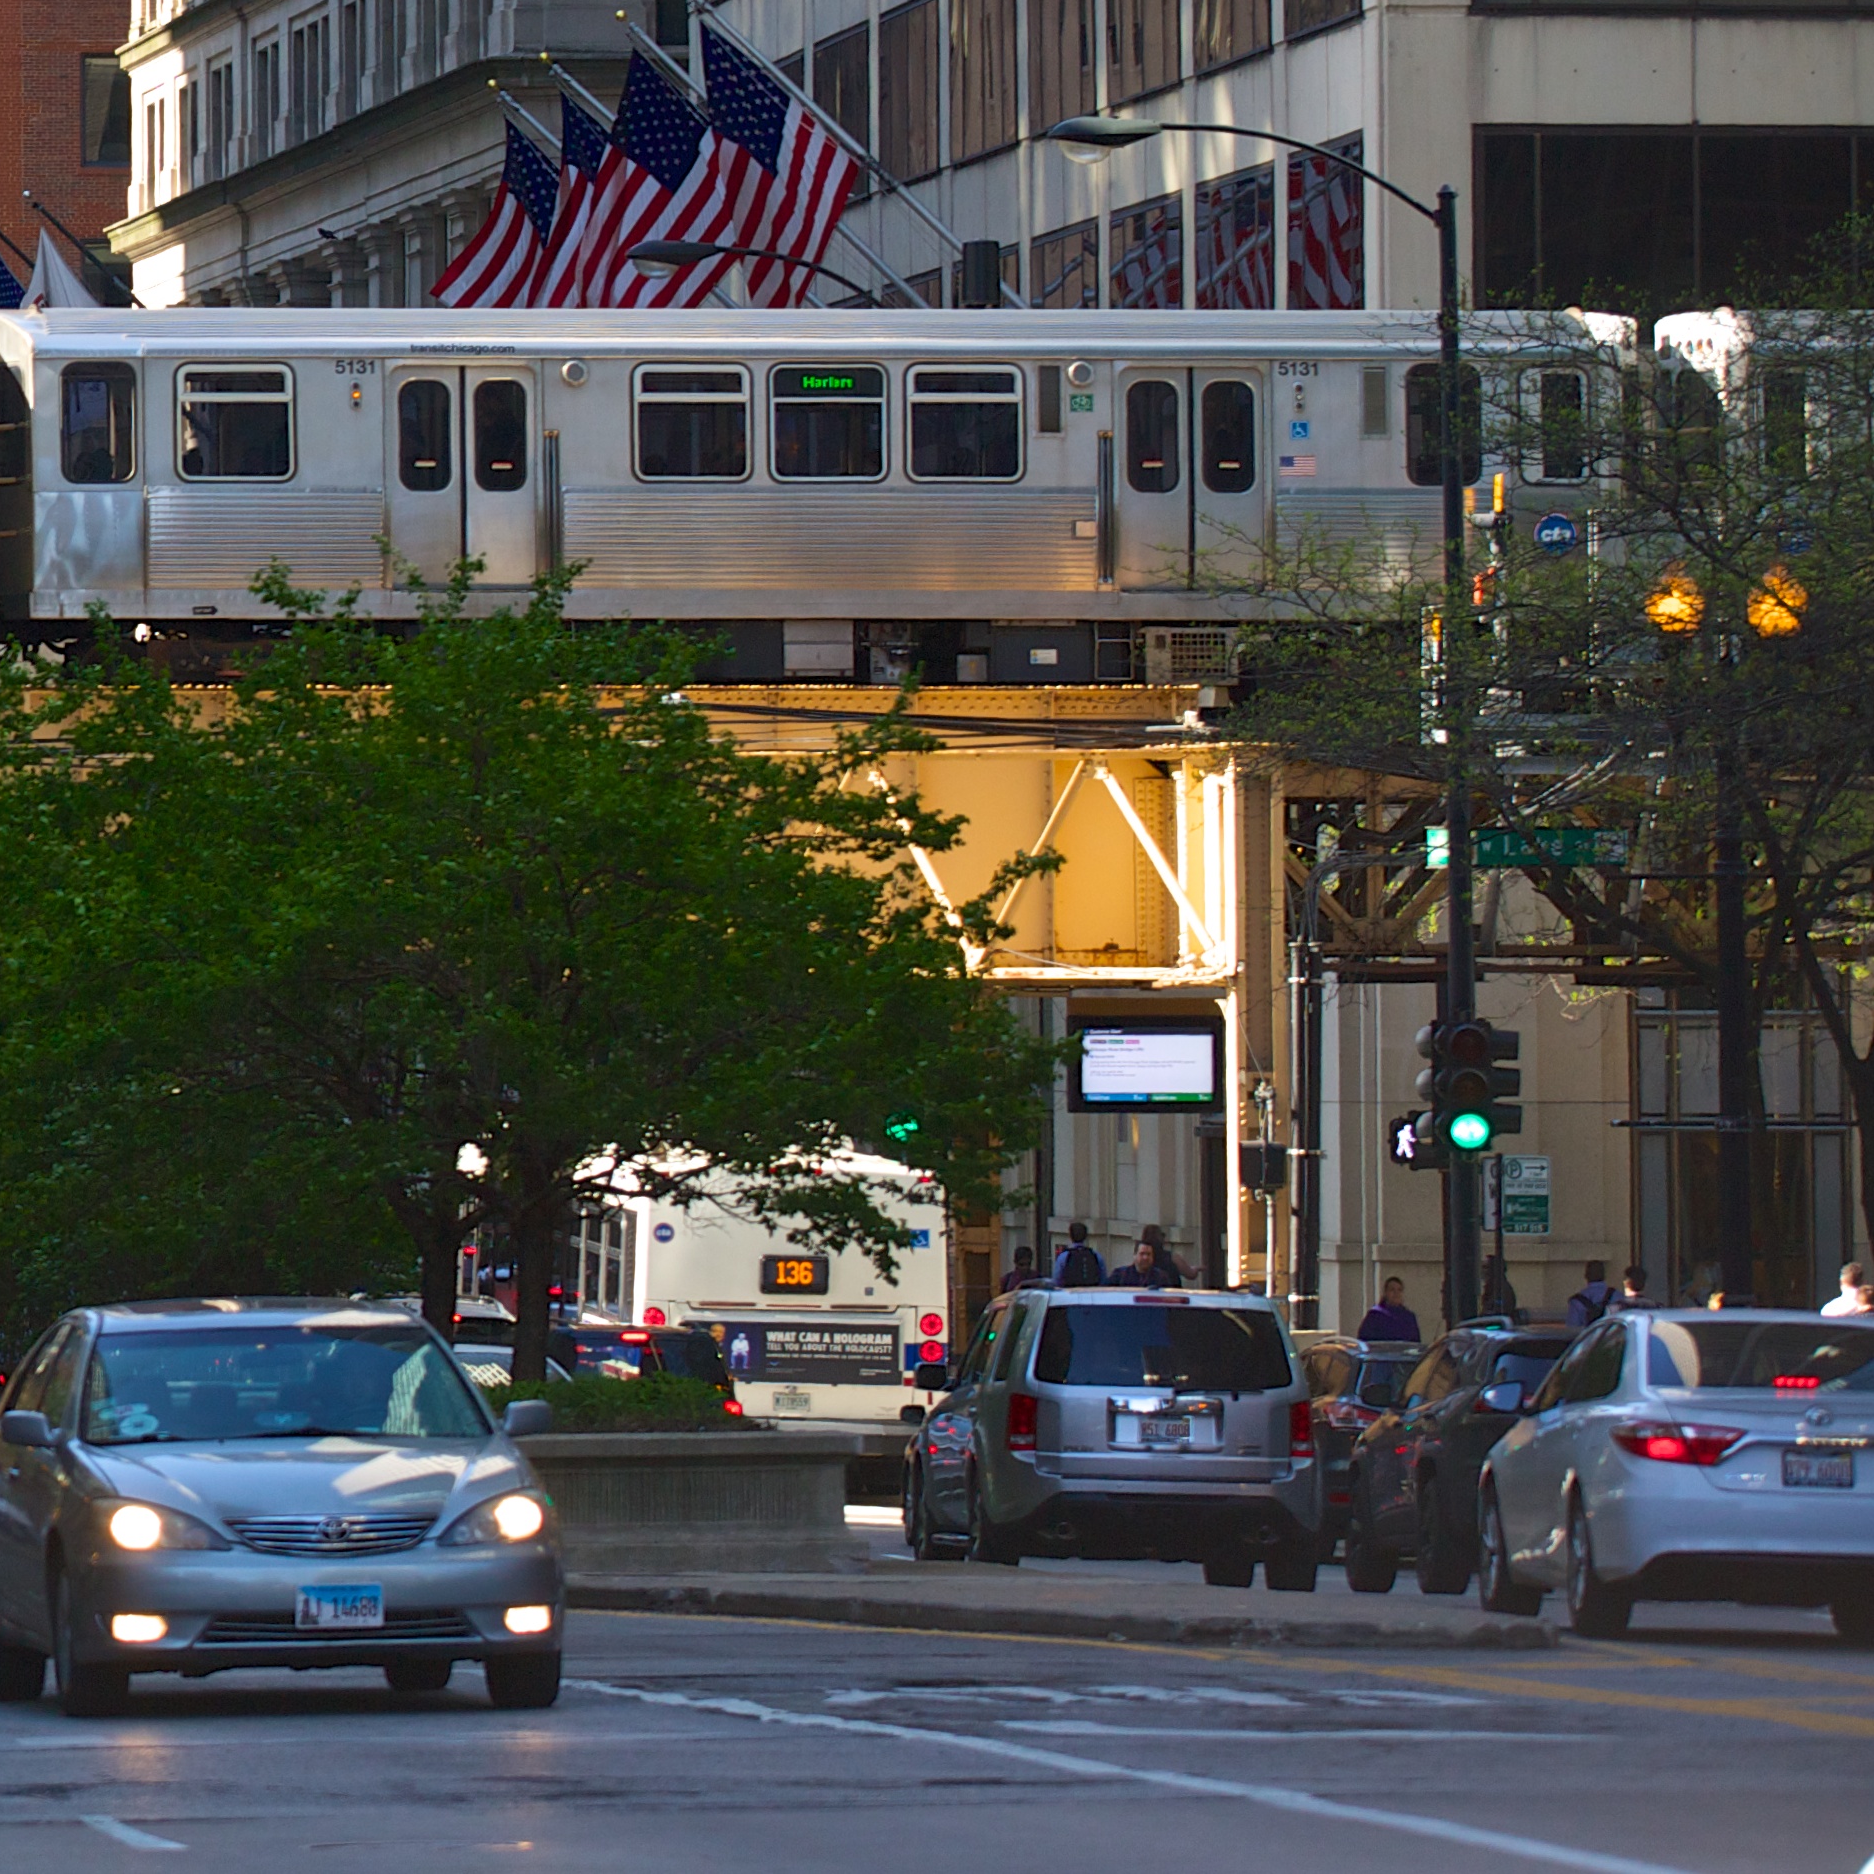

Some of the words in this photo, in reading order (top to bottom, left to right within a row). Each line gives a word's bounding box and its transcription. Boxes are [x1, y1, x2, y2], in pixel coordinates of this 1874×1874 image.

[410, 343, 515, 355] transitchicago.com
[334, 360, 375, 374] 5131
[1278, 361, 1318, 376] 5131
[776, 1261, 814, 1285] 136
[765, 1331, 797, 1342] WHAT
[798, 1332, 821, 1343] CAN
[822, 1332, 831, 1343] A
[833, 1333, 893, 1344] HOLOGRAM
[766, 1343, 783, 1351] TELL
[784, 1343, 799, 1351] YOU
[802, 1344, 827, 1352] ABOUT
[829, 1344, 842, 1352] THE
[845, 1345, 893, 1354] HOLOCAUST?
